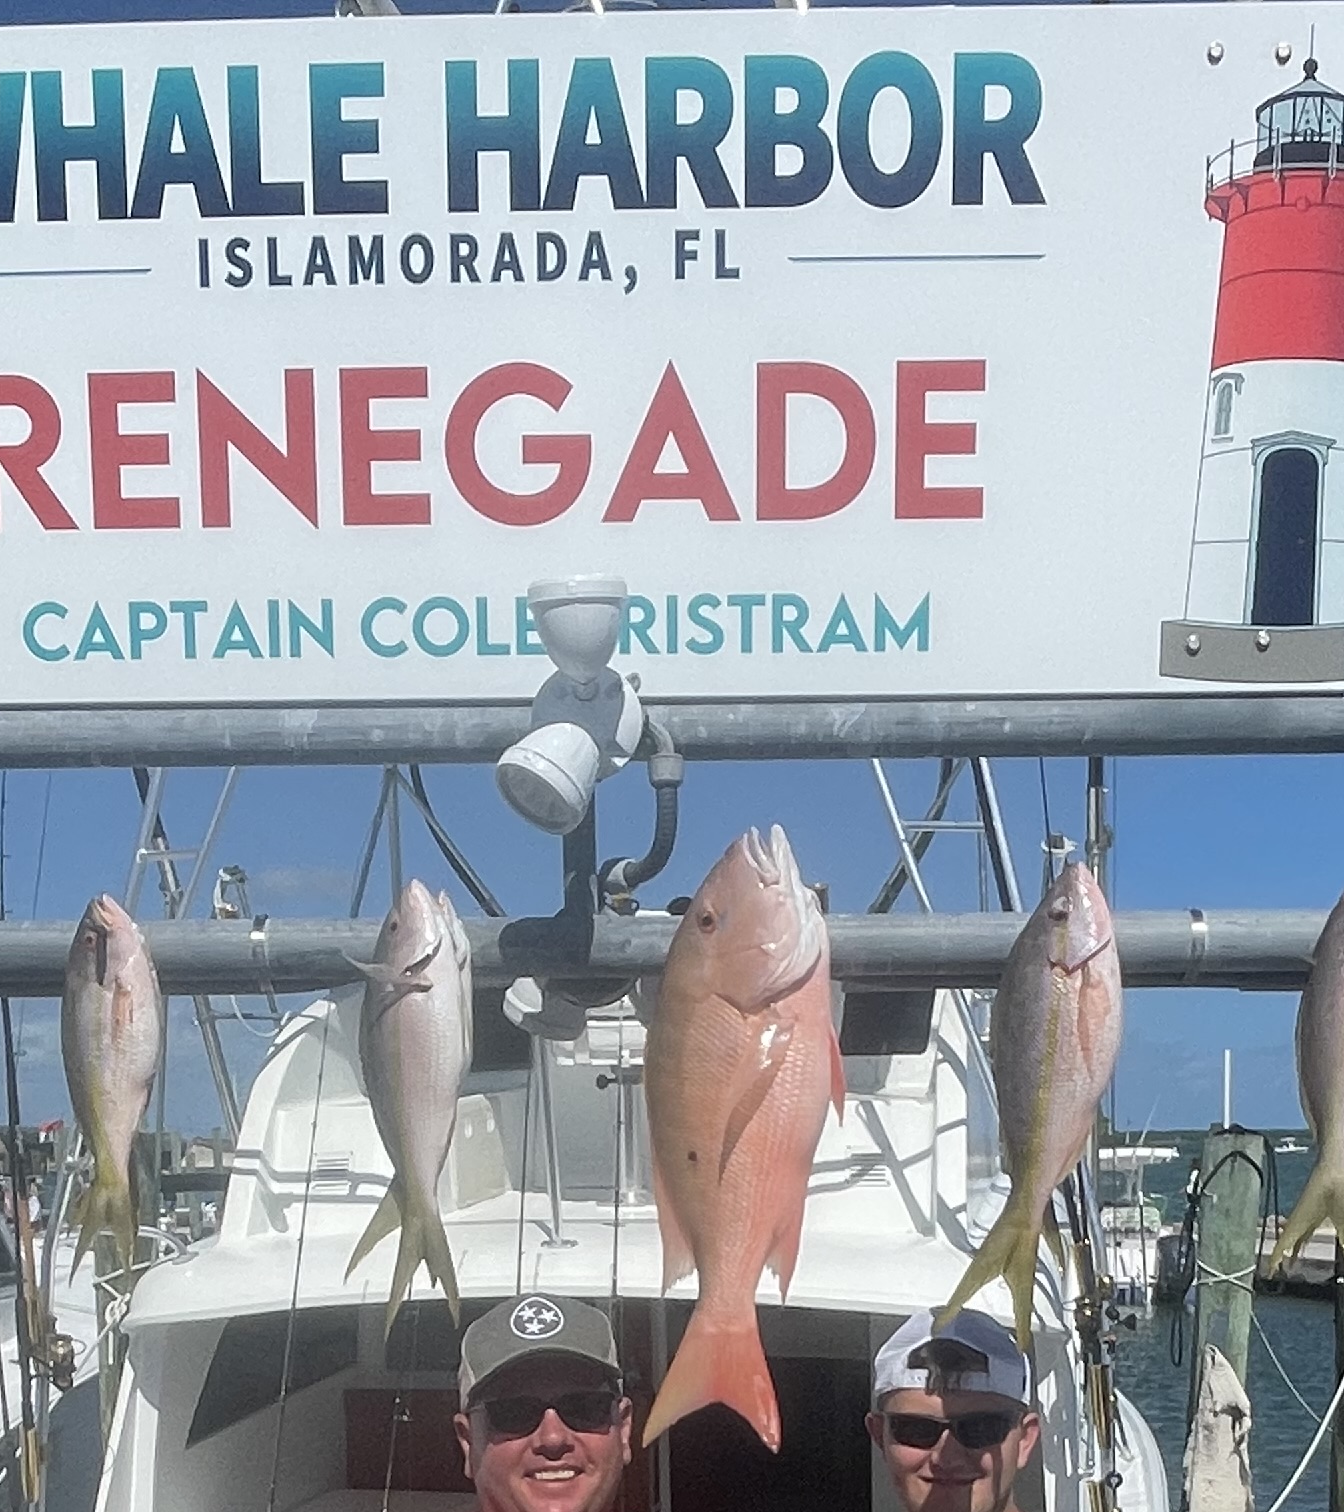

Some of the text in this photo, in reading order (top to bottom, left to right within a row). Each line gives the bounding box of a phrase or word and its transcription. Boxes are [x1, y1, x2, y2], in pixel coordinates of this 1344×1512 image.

[445, 50, 1047, 214] HARBOR
[198, 229, 742, 296] ISLAMORADA, FL
[22, 592, 931, 662] CAPTAIN COLE RISTRAM
